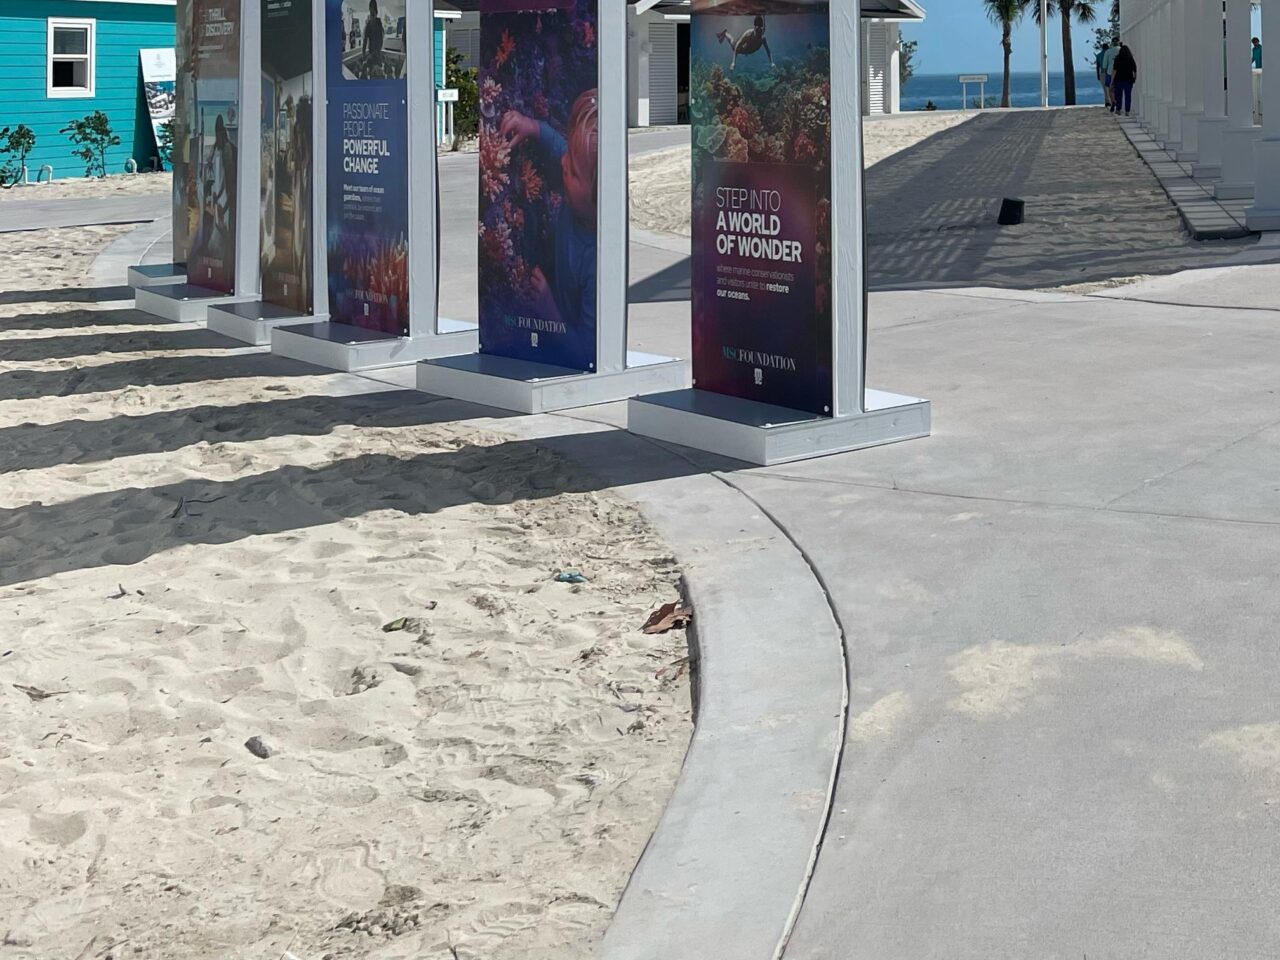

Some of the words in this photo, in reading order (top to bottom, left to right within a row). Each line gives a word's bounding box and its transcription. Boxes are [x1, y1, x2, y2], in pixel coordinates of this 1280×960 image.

[208, 7, 226, 21] THRILL
[206, 21, 235, 37] DISCOVERY
[343, 102, 390, 120] PASSIONATE
[343, 139, 391, 157] POWERFUL
[343, 156, 379, 174] CHANGE
[716, 186, 748, 209] STEP
[749, 188, 781, 212] INTO
[716, 211, 727, 231] A
[728, 211, 781, 236] WORLD
[716, 233, 737, 255] OF
[737, 236, 802, 263] WONDER
[716, 288, 727, 297] our
[766, 282, 789, 294] restore
[518, 316, 567, 334] FOUNDATION
[738, 348, 797, 371] FOUNDATION
